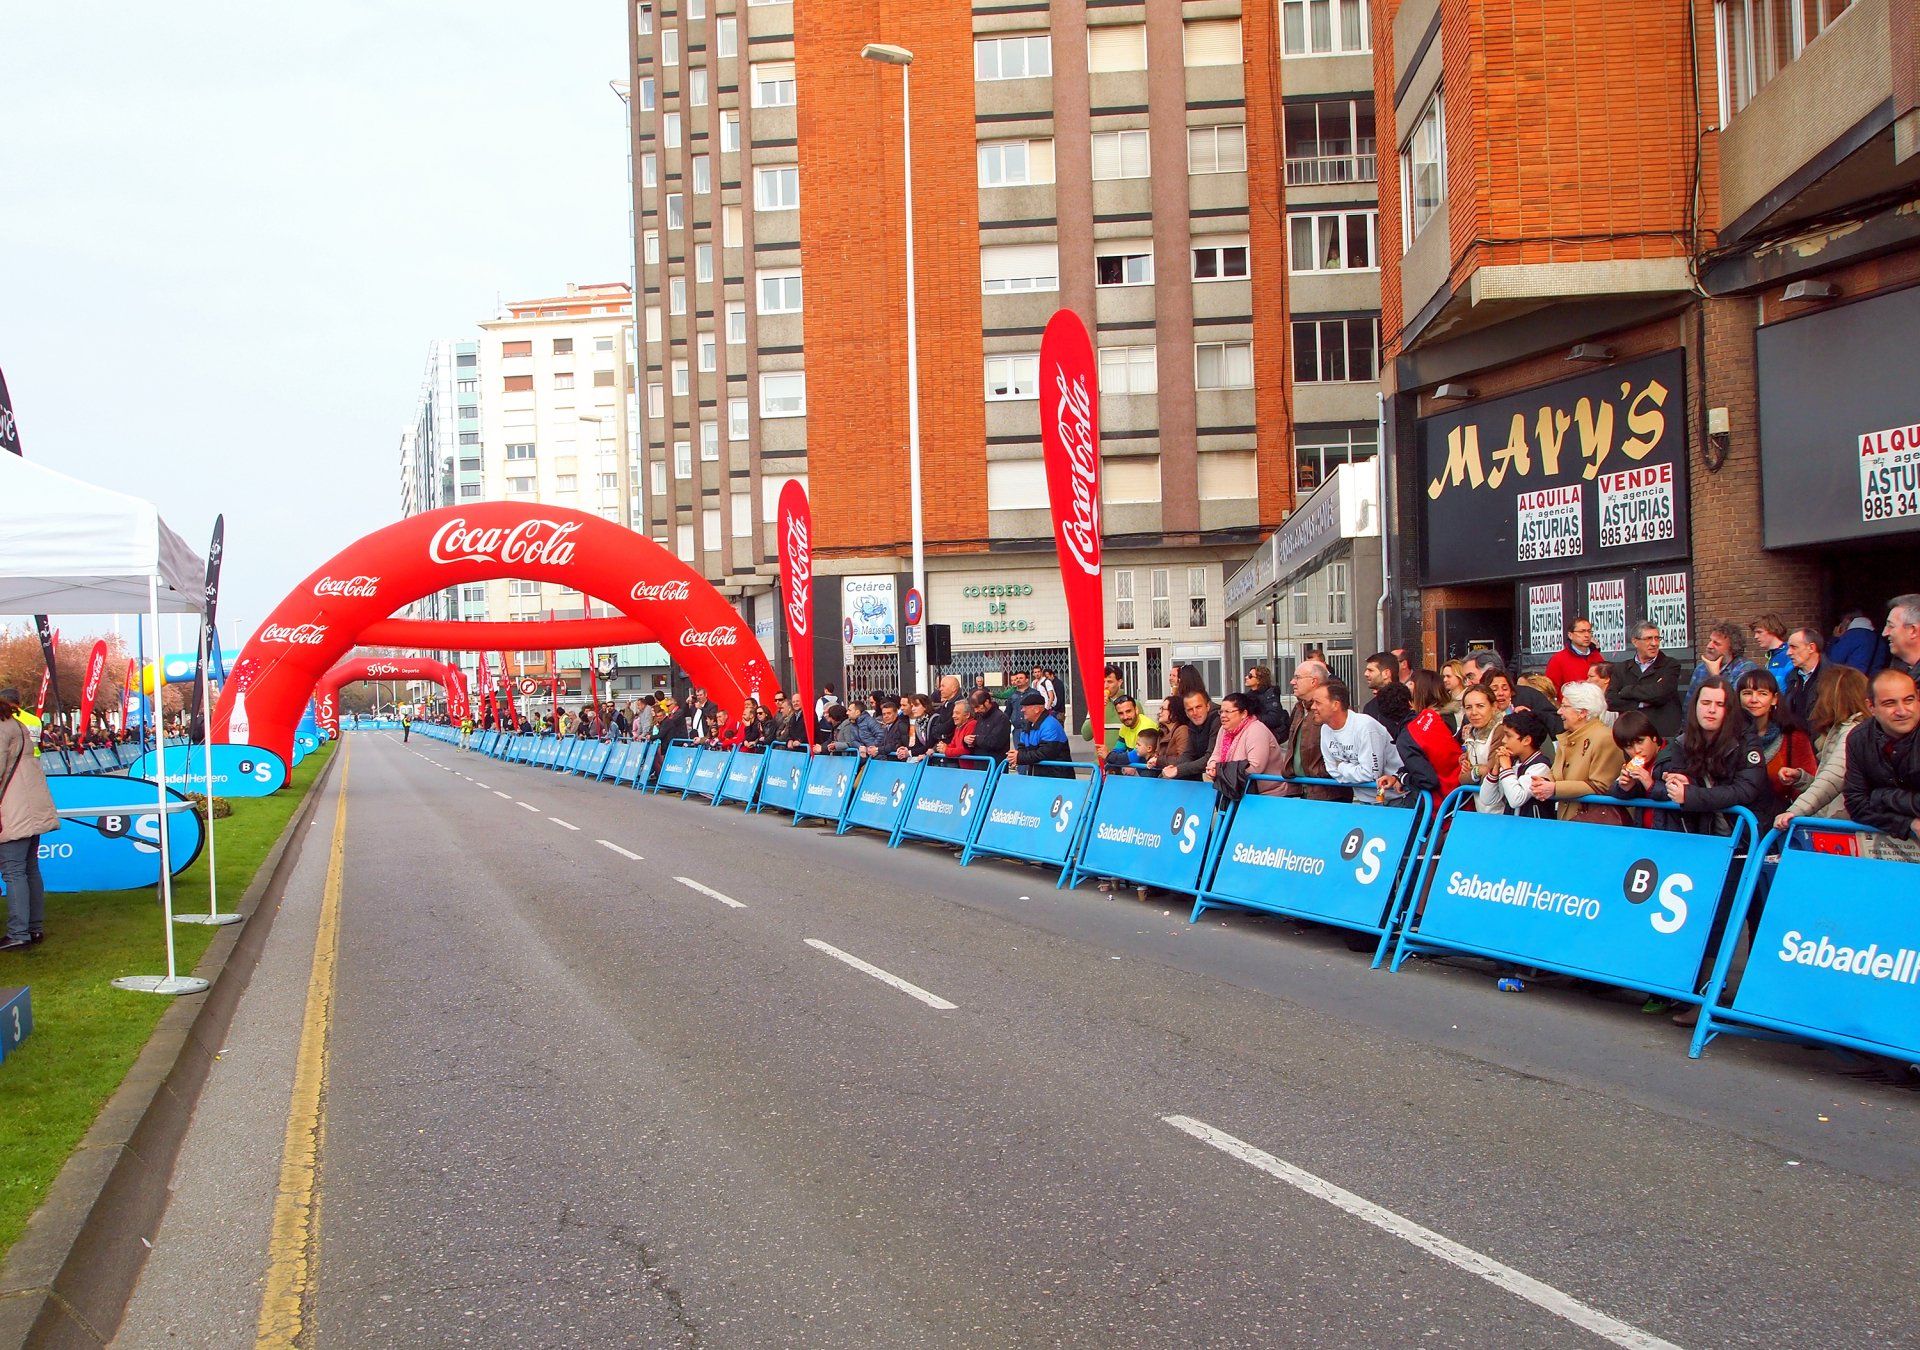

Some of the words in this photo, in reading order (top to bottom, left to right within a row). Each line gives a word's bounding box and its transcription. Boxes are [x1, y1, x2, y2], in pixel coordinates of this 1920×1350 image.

[1056, 362, 1101, 576] Coca-Cola
[1600, 464, 1671, 493] VENDE
[1519, 486, 1580, 511] ALQUILA
[1623, 486, 1664, 500] agencia
[1538, 507, 1574, 518] agencia
[1603, 495, 1669, 527] ASTURIAS
[1864, 496, 1893, 519] 985
[1898, 492, 1917, 515] 34
[1521, 514, 1579, 542] ASTURIAS
[1601, 526, 1621, 546] 985
[1624, 524, 1638, 543] 34
[1641, 521, 1655, 540] 49
[1658, 518, 1672, 538] 99
[429, 518, 583, 566] Coca-Cola
[1519, 542, 1537, 560] 985
[1539, 540, 1551, 557] 34
[1553, 539, 1566, 556] 49
[1568, 537, 1581, 554] 99
[787, 509, 809, 636] Coca-Cola
[313, 575, 381, 597] Coca-Cola
[630, 580, 691, 601] Coca-Cola
[846, 581, 892, 592] Cetárea
[963, 584, 1032, 597] COCEDERO
[1531, 586, 1561, 605] ALQUILA
[1590, 581, 1623, 600] ALQUILA
[1648, 574, 1685, 596] ALQUILA
[989, 602, 1006, 614] DE
[1649, 604, 1686, 626] ASTURIAS
[1532, 611, 1562, 633] ASTURIAS
[1591, 609, 1624, 631] ASTURIAS
[260, 623, 329, 645] Coca-Cola
[680, 626, 737, 647] Coca-Cola
[366, 662, 399, 677] gijón
[1173, 813, 1182, 828] B
[1179, 814, 1200, 854] S
[1344, 835, 1359, 854] B
[1355, 837, 1386, 885] S
[1631, 869, 1650, 893] B
[1650, 872, 1693, 934] S
[12, 1006, 21, 1041] 3
